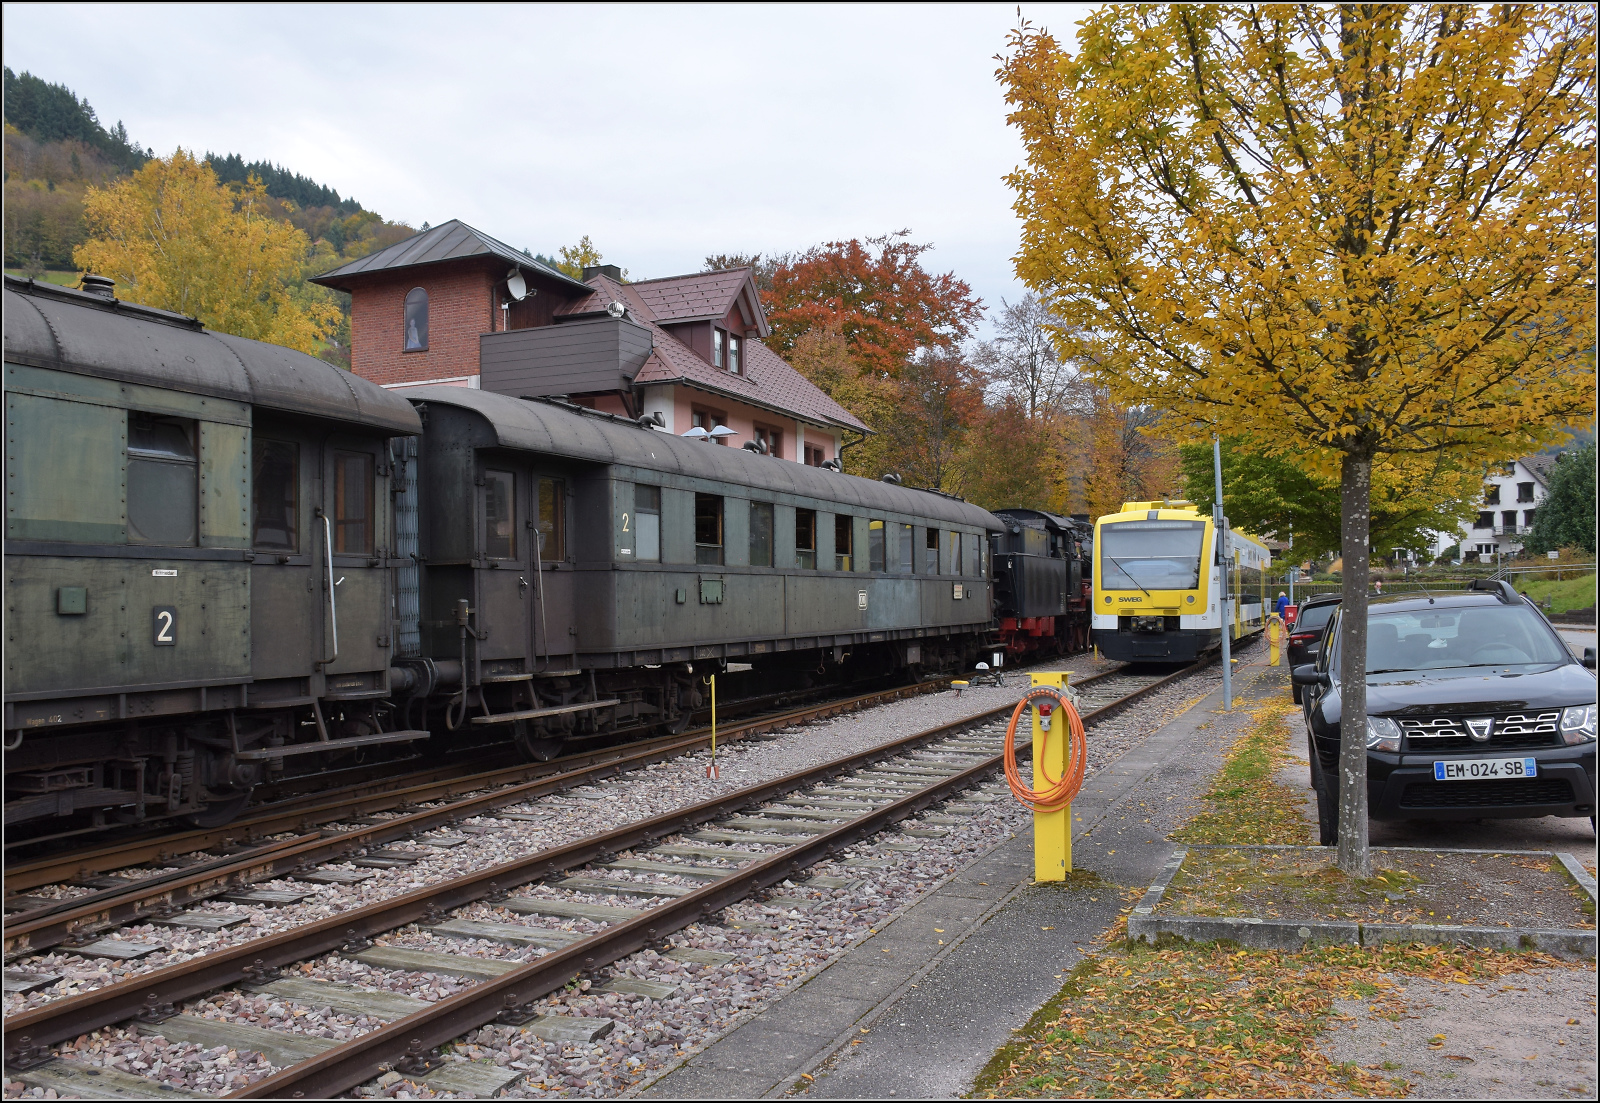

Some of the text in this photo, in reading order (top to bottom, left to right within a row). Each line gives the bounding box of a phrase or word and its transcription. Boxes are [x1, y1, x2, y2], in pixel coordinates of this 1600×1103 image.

[622, 513, 629, 532] 2
[157, 611, 173, 642] 2
[26, 714, 62, 726] Wagen 402
[1445, 762, 1523, 777] EM-024-SB
